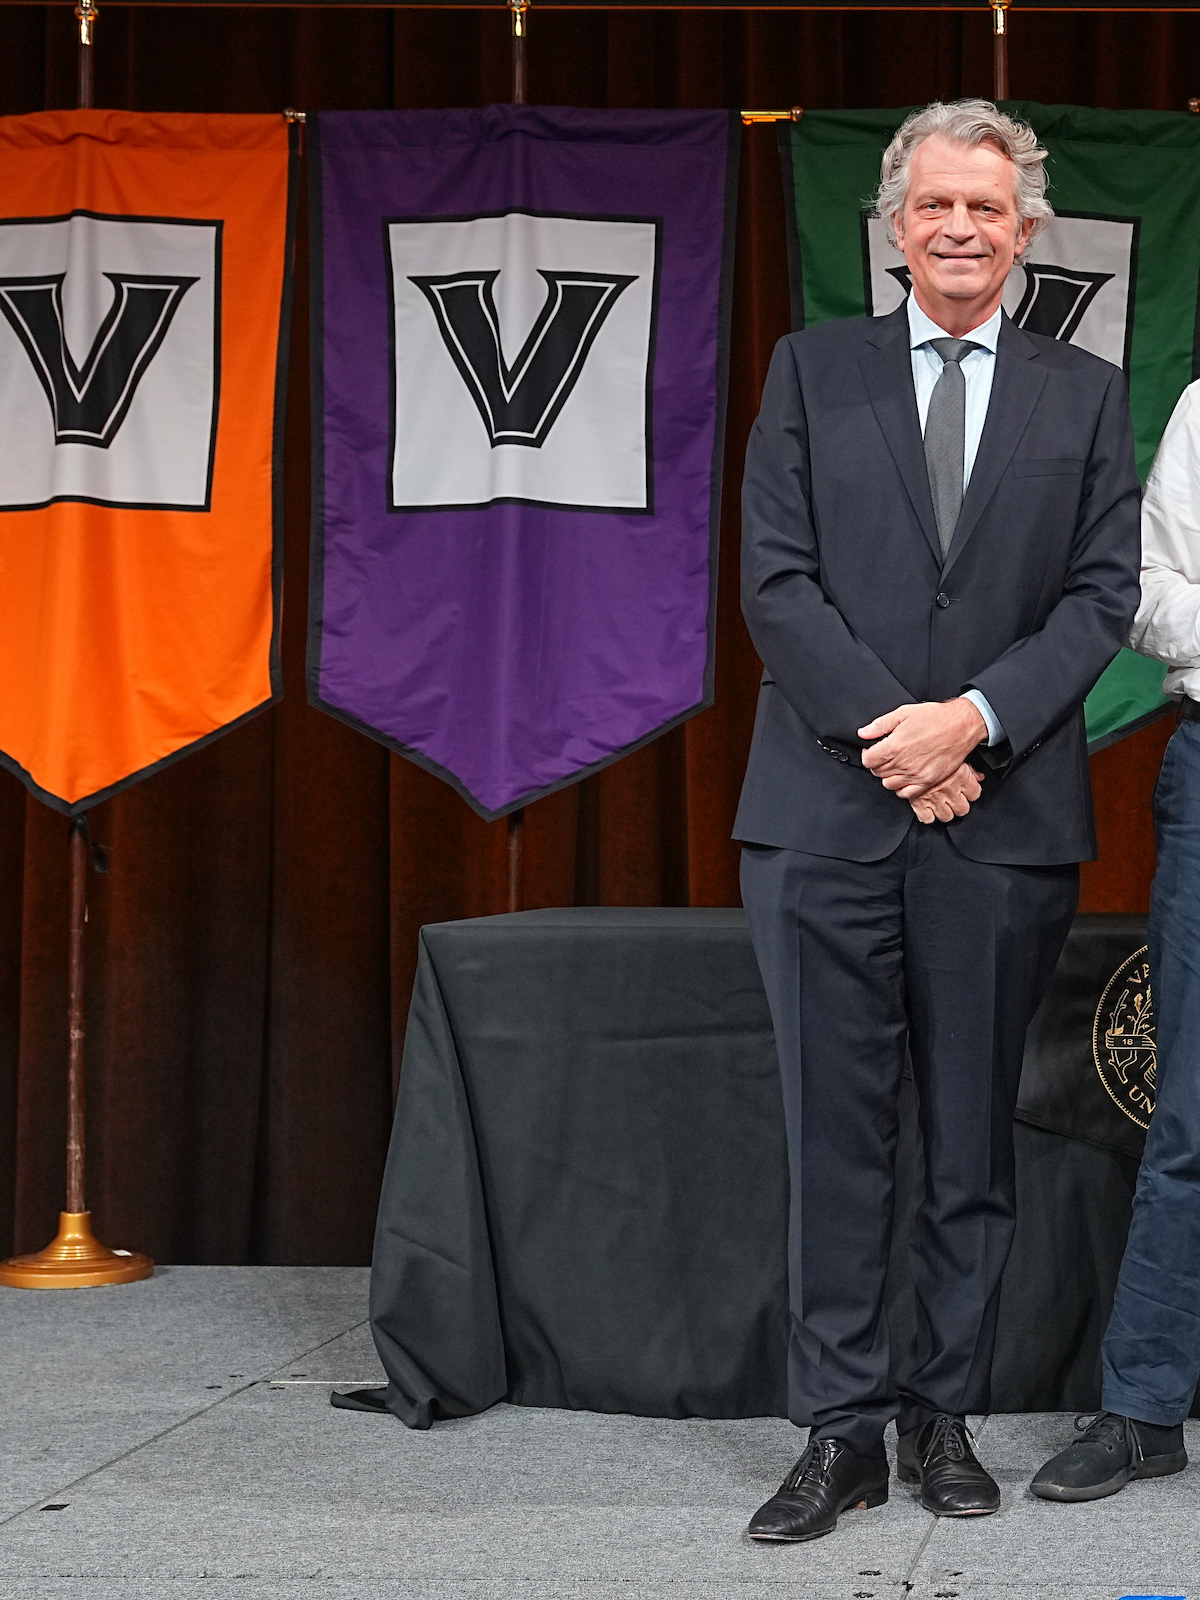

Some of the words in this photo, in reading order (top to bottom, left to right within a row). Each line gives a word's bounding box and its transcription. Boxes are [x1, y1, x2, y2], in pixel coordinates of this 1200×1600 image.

[0, 271, 201, 449] V
[406, 270, 640, 449] V
[1122, 1038, 1134, 1046] 18
